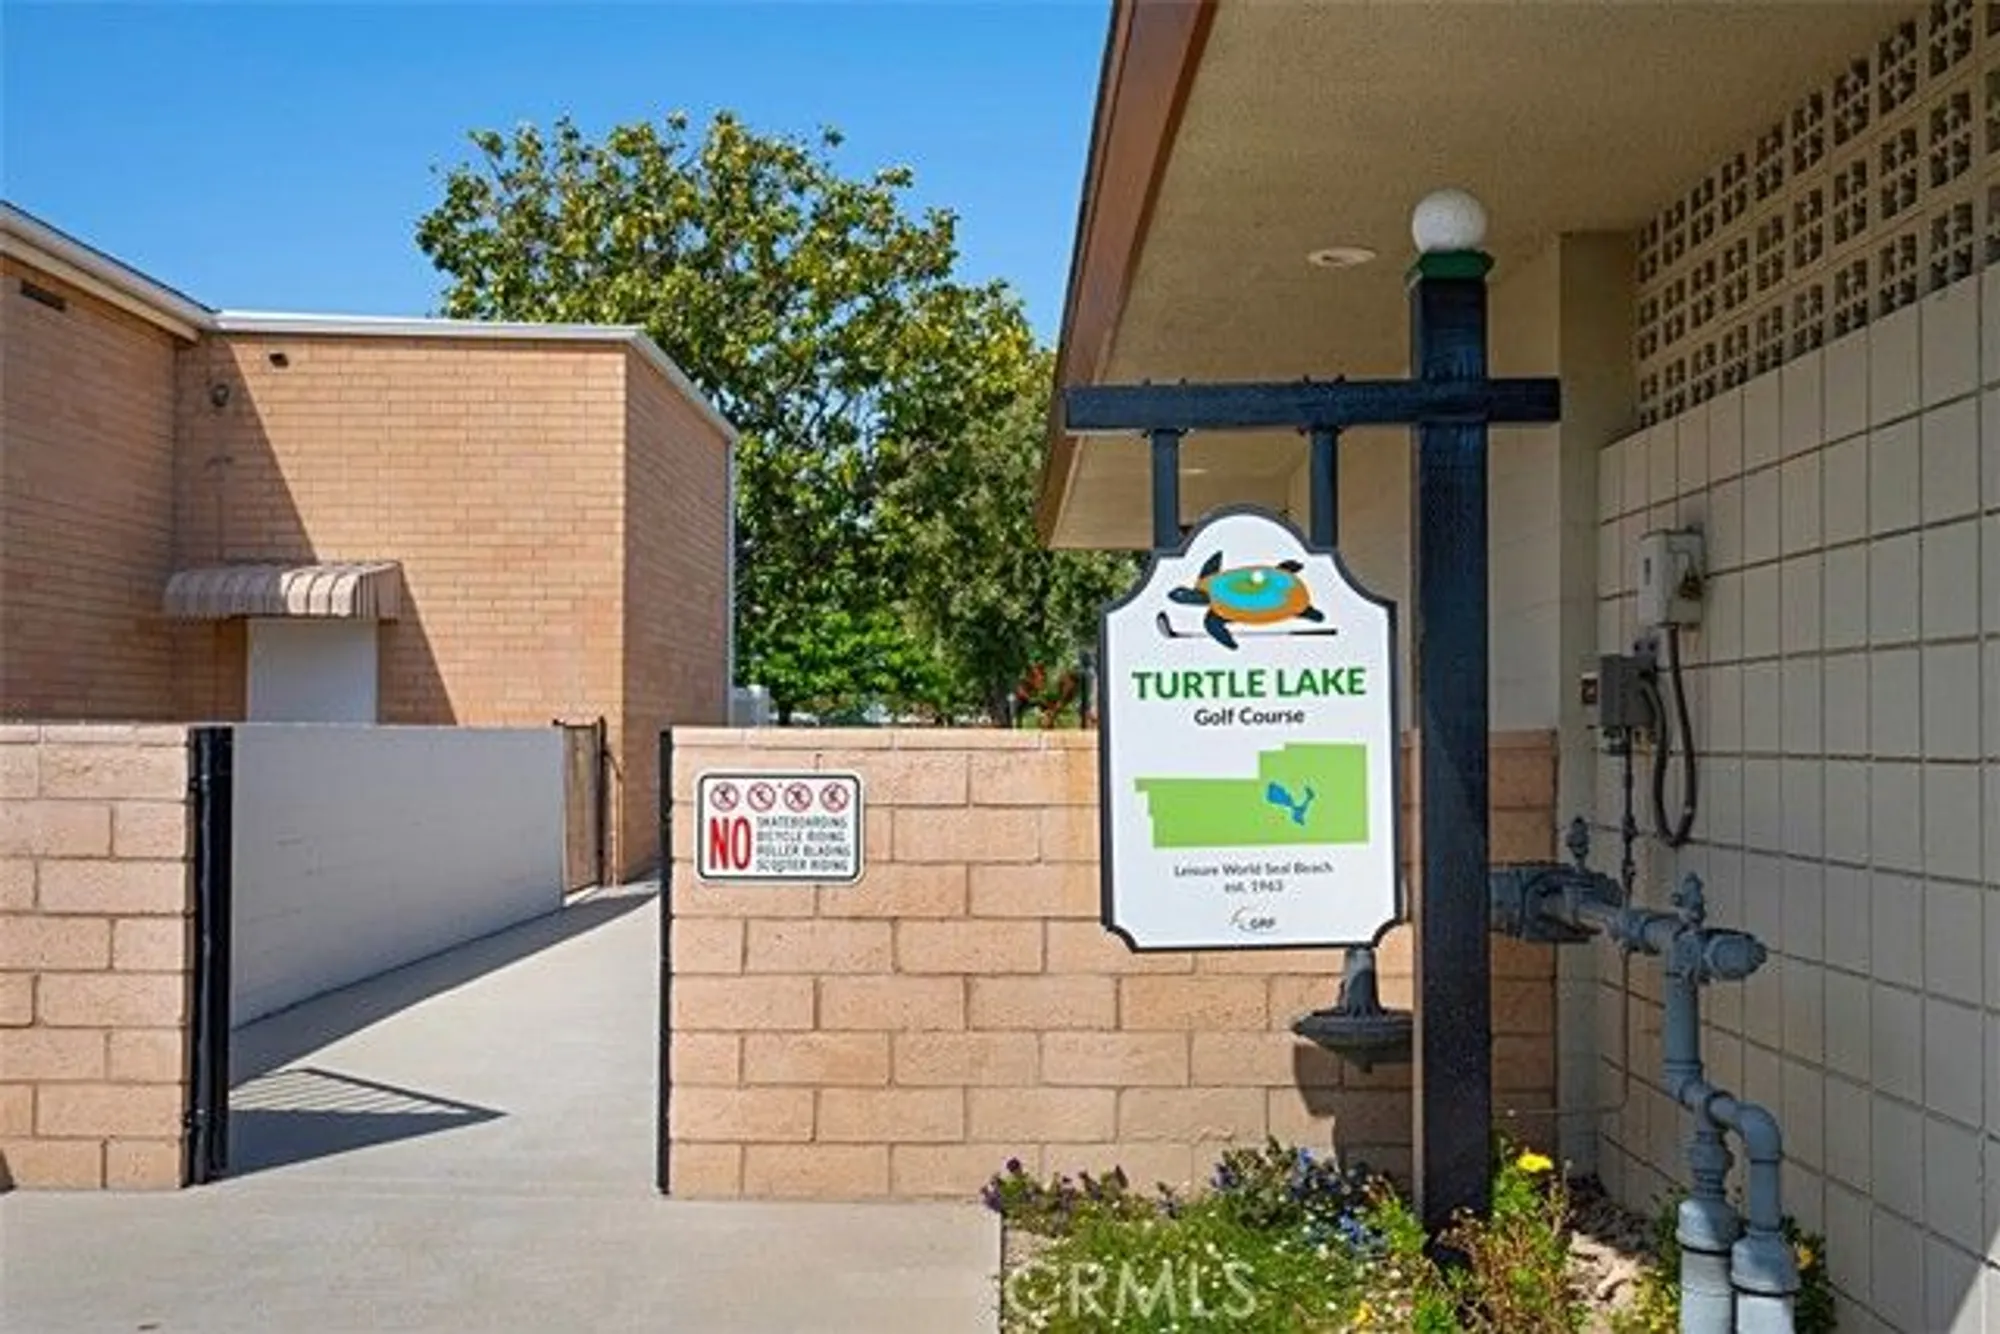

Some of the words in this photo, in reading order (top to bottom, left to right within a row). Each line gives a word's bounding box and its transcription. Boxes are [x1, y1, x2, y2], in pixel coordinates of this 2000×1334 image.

[1132, 669, 1266, 700] TURTLE
[1276, 667, 1367, 697] LAKE
[1194, 708, 1234, 726] Golf
[1239, 706, 1305, 725] Course
[709, 816, 752, 870] NO
[1174, 865, 1219, 877] Leisure
[1222, 863, 1262, 876] World
[1265, 862, 1291, 875] Seal
[1294, 862, 1333, 874] Beach
